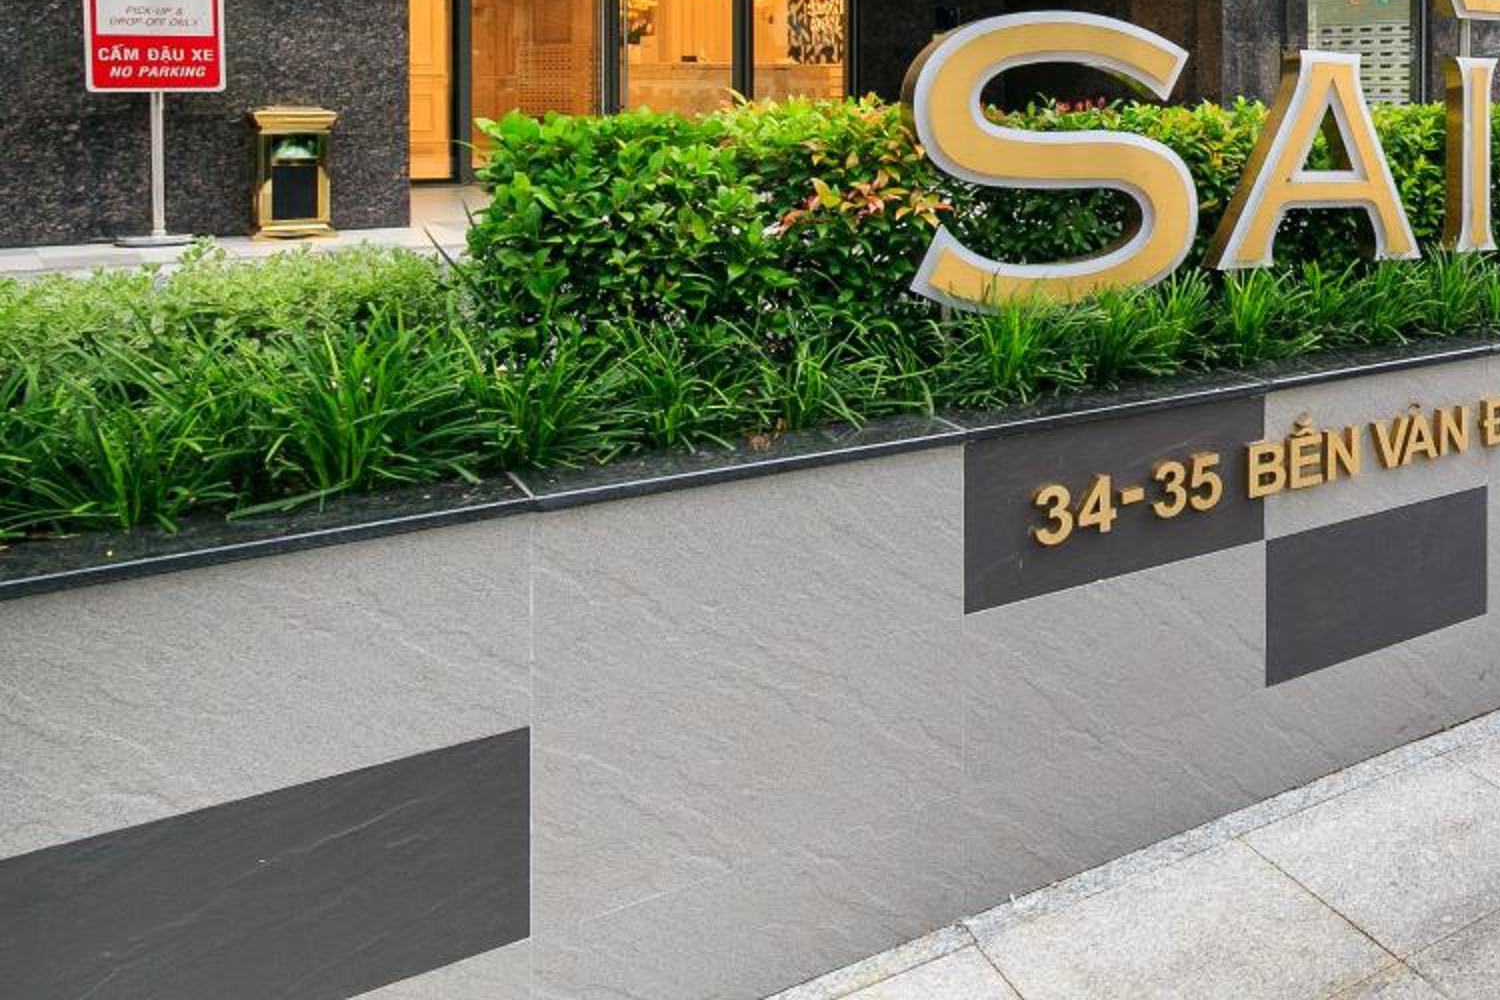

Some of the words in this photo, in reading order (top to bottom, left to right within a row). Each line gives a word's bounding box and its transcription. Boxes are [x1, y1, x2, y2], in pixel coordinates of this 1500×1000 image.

[98, 43, 139, 61] CẤM
[191, 49, 214, 61] XE
[109, 66, 133, 78] NO
[138, 66, 207, 78] PARKING
[1033, 451, 1223, 547] 34-35
